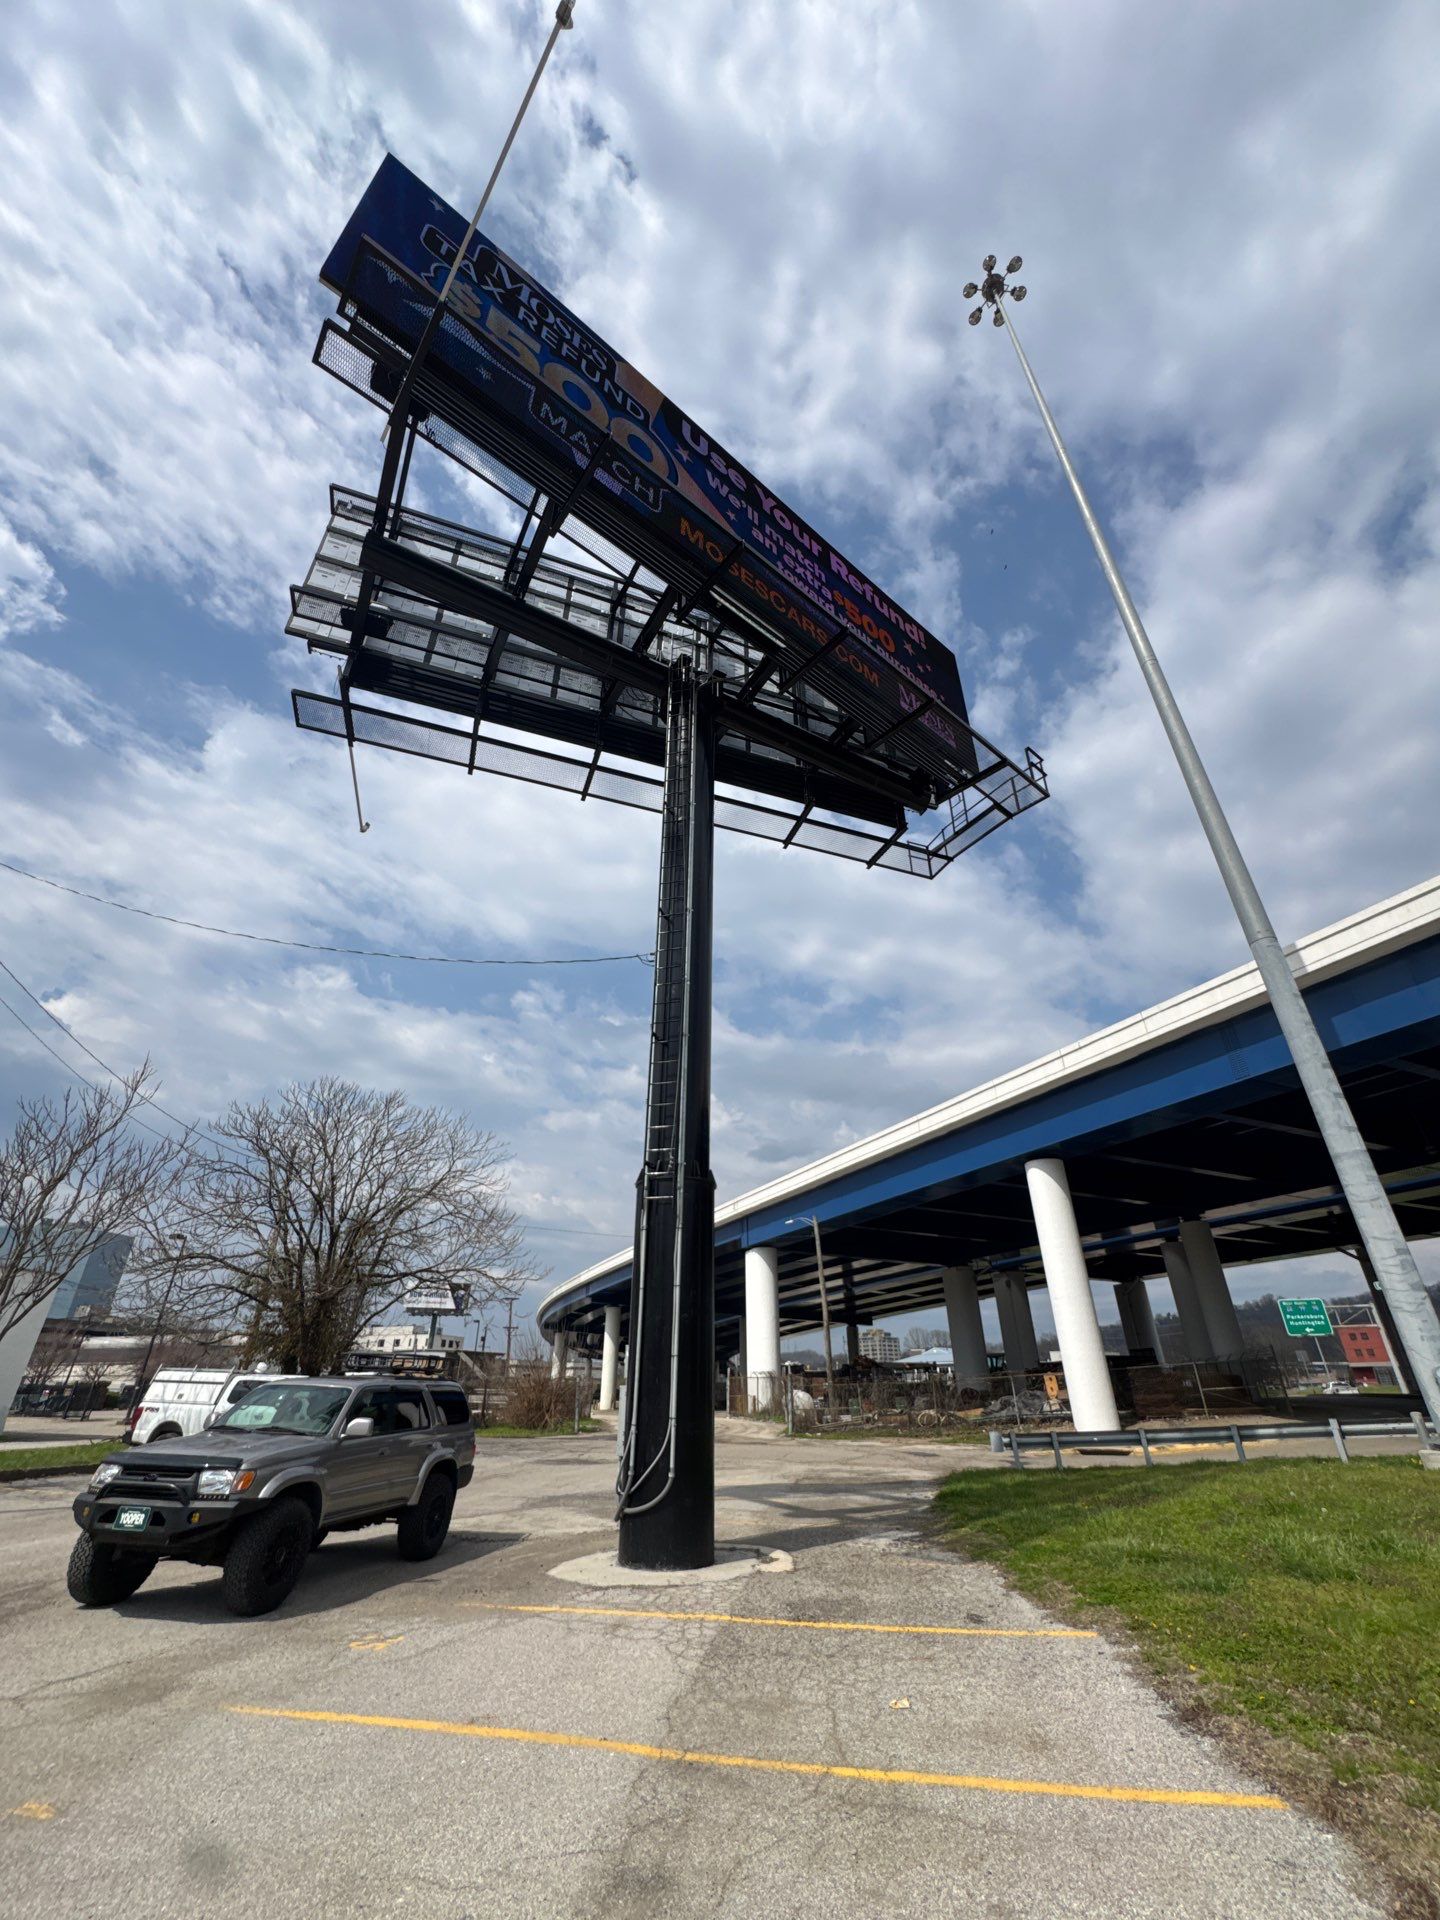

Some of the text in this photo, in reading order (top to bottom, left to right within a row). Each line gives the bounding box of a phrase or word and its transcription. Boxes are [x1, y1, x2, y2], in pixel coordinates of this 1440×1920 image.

[435, 233, 645, 420] TAX REFUND
[484, 260, 607, 371] MOSES
[447, 279, 671, 480] $500
[681, 419, 748, 492] Use
[752, 482, 823, 558] Your
[829, 550, 928, 651] Refund!
[705, 468, 827, 583] We'll match
[751, 527, 778, 556] an
[782, 554, 833, 601] extra
[832, 589, 896, 653] $500
[119, 1512, 146, 1525] YOOPER
